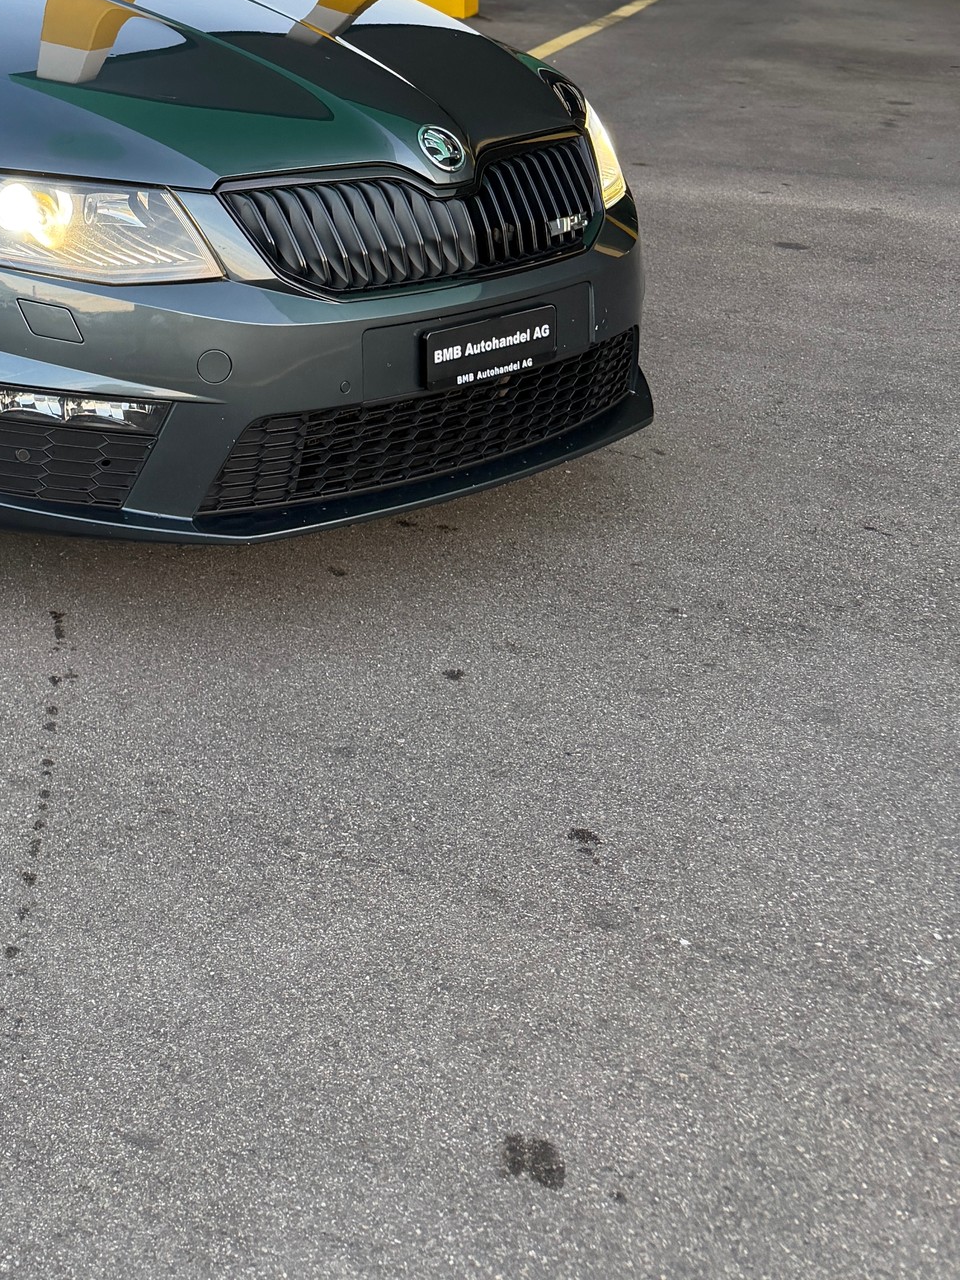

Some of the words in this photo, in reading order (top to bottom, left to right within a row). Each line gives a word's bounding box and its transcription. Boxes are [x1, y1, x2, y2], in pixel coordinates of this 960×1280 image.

[434, 345, 463, 364] BMB
[464, 328, 531, 357] Autohandel
[533, 324, 550, 340] AG
[456, 372, 475, 385] BMB
[476, 360, 521, 380] Autohandel
[521, 357, 533, 369] AG
